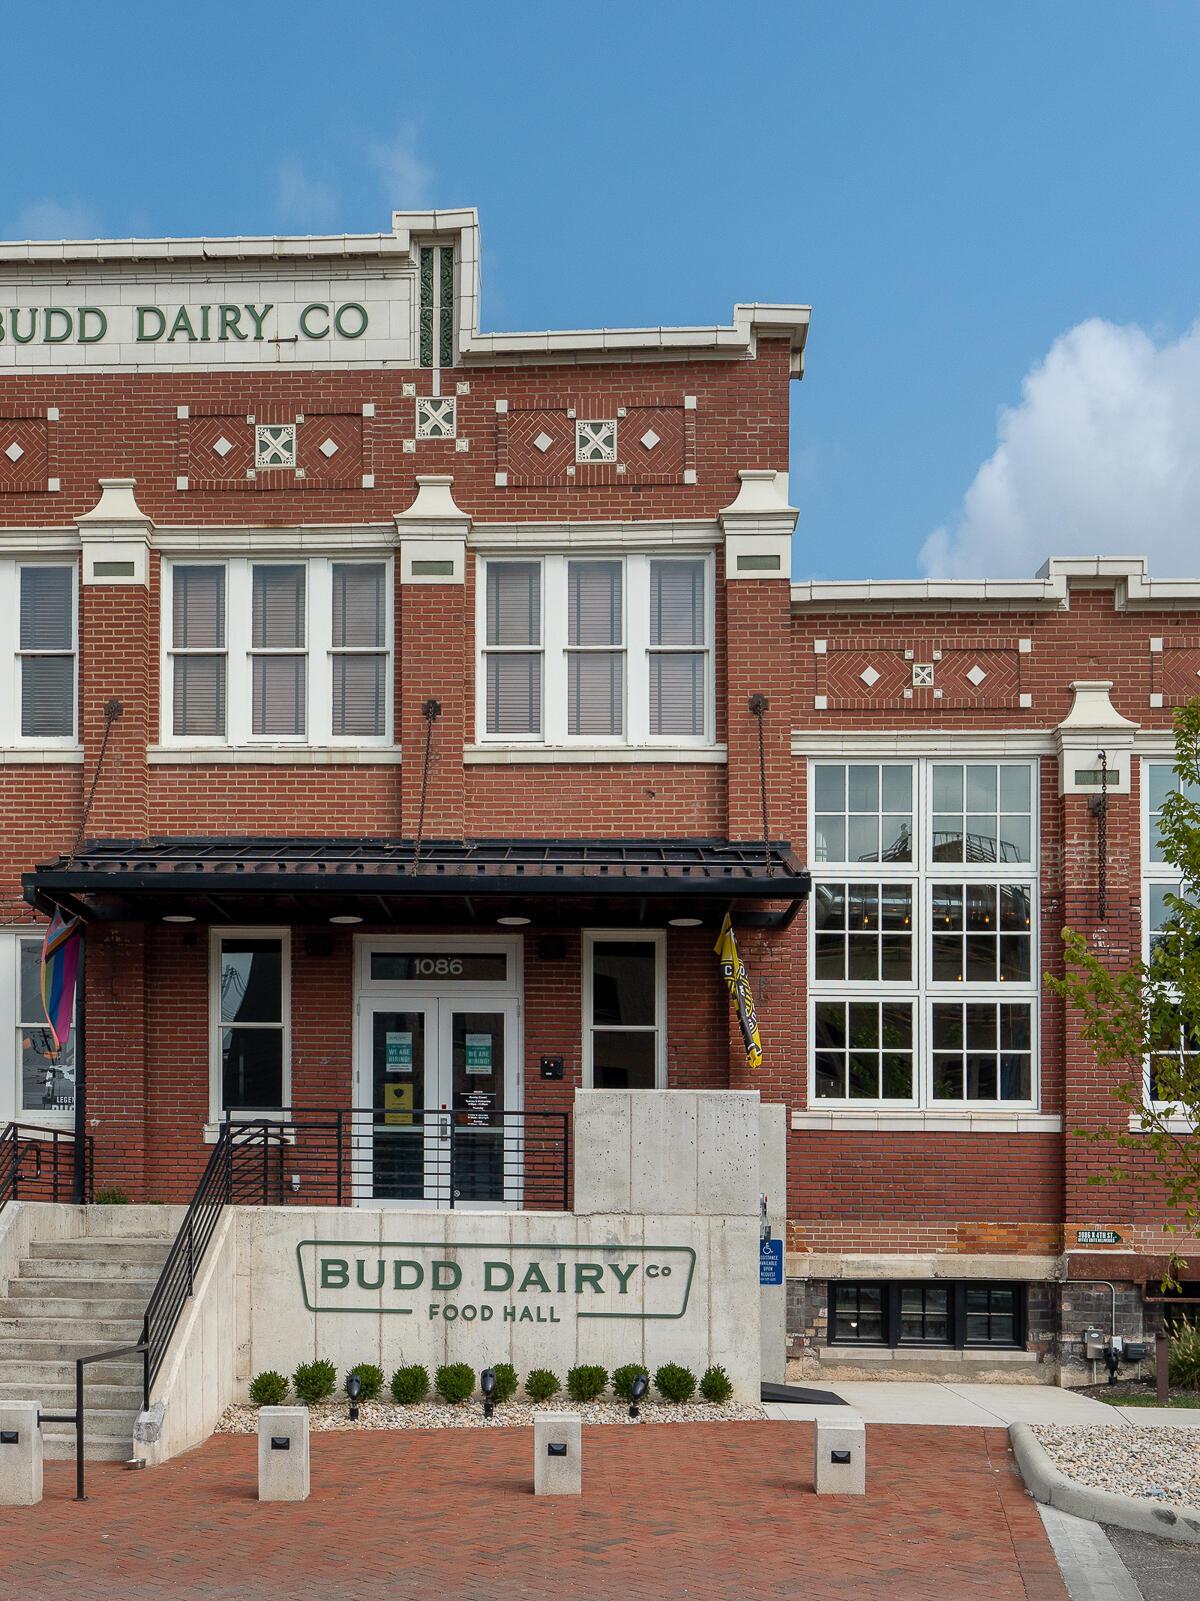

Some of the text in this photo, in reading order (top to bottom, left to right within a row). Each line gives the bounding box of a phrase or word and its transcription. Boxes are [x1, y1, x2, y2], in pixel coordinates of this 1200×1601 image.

[136, 304, 274, 343] DAIRY
[299, 302, 369, 339] CO
[414, 958, 464, 975] 1086
[320, 1258, 463, 1290] BUDD
[483, 1261, 639, 1294] DAIRY
[429, 1303, 561, 1323] FOOD HALL
